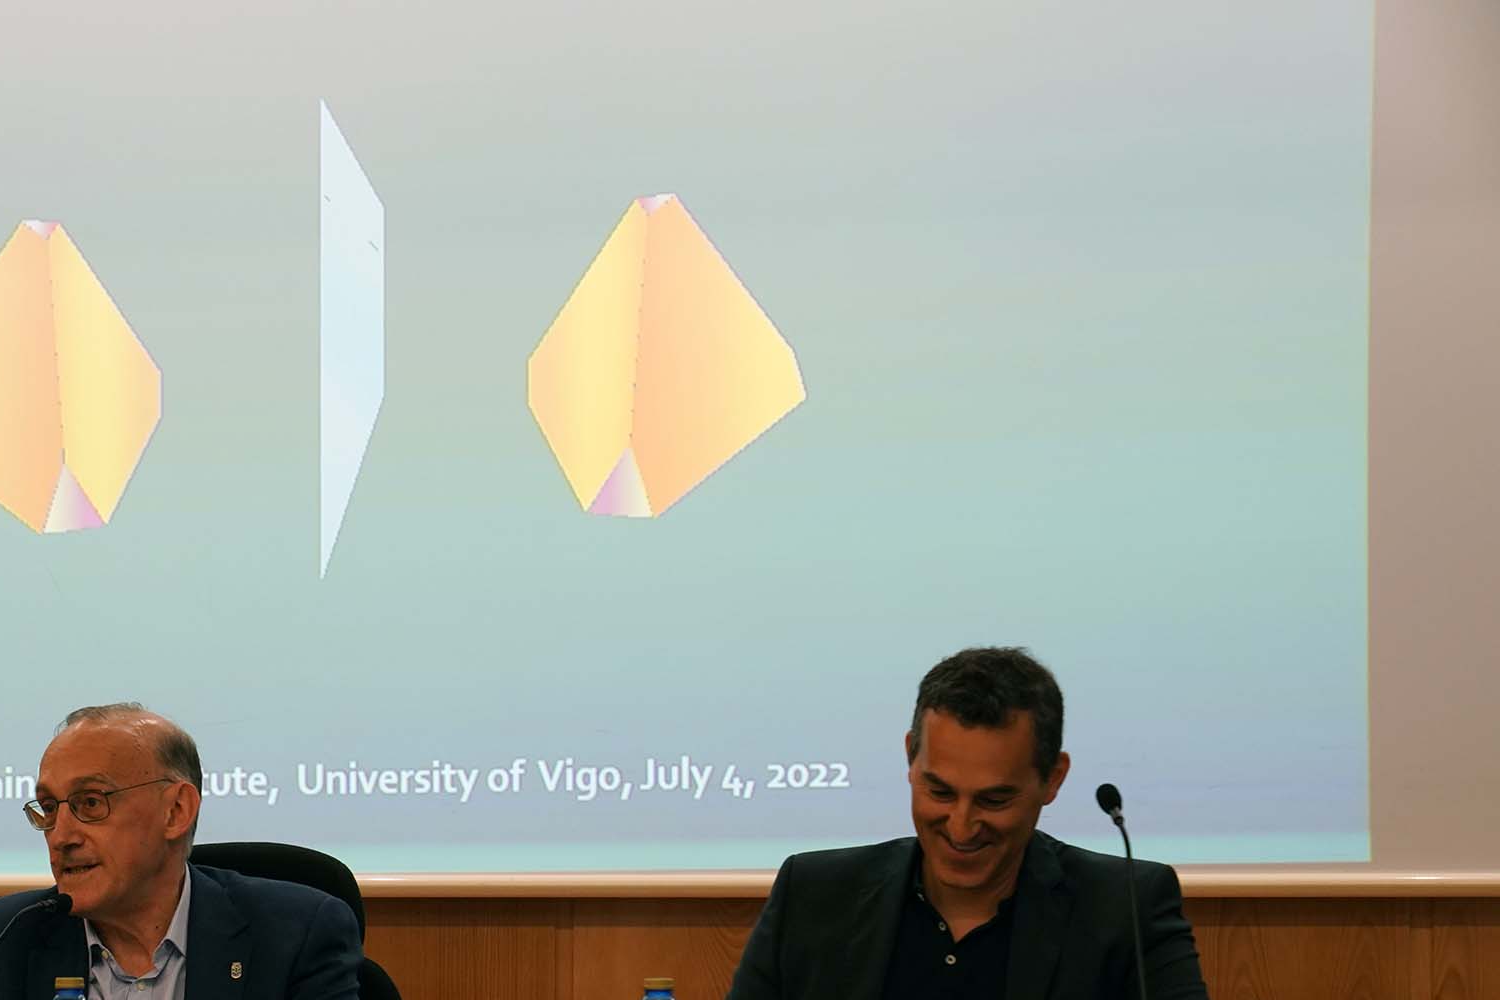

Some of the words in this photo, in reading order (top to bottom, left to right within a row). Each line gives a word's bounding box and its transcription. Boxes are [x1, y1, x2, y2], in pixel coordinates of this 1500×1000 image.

[202, 767, 278, 806] tute,
[297, 763, 479, 802] University
[487, 759, 526, 792] of
[538, 760, 633, 801] Vigo,
[640, 757, 713, 799] July
[721, 763, 755, 799] 4,
[768, 763, 850, 789] 2022
